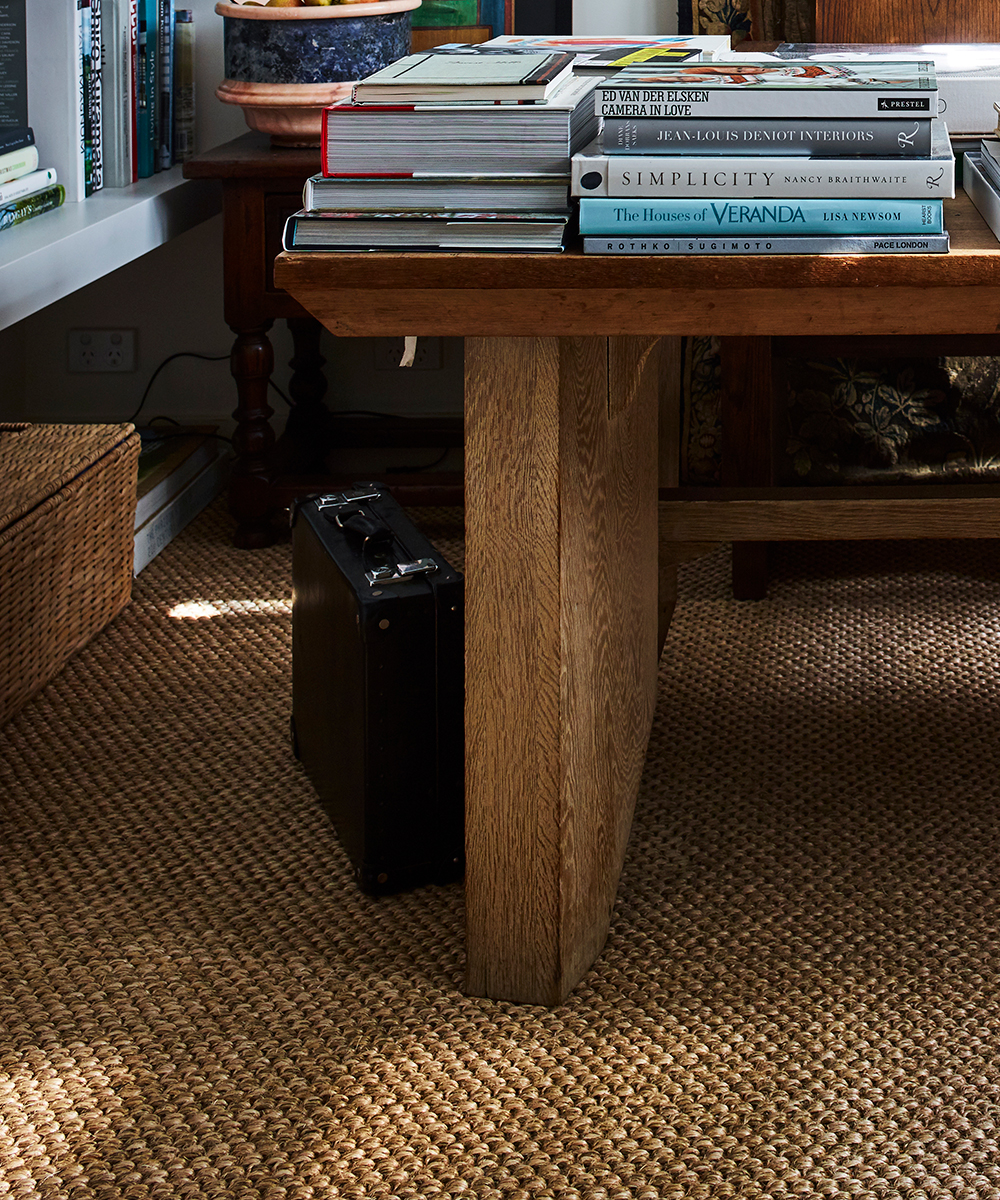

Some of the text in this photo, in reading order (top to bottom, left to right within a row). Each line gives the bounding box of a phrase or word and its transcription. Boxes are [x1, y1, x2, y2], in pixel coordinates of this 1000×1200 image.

[601, 90, 710, 103] ED VAN DER ELSKEN
[890, 100, 925, 108] PRESTEL
[601, 104, 692, 116] CAMERA IN LOVE
[91, 68, 103, 189] Kuramata
[656, 130, 874, 141] JEAN-LOUIS DENIOT INTERIORS
[621, 171, 774, 187] SIMPLICITY
[828, 176, 907, 184] BRAITHWAITE
[613, 202, 807, 226] The Houses of VERANDA
[823, 211, 902, 221] LISA NEWSOM
[607, 242, 773, 250] ROTHKO SUGIMOTO
